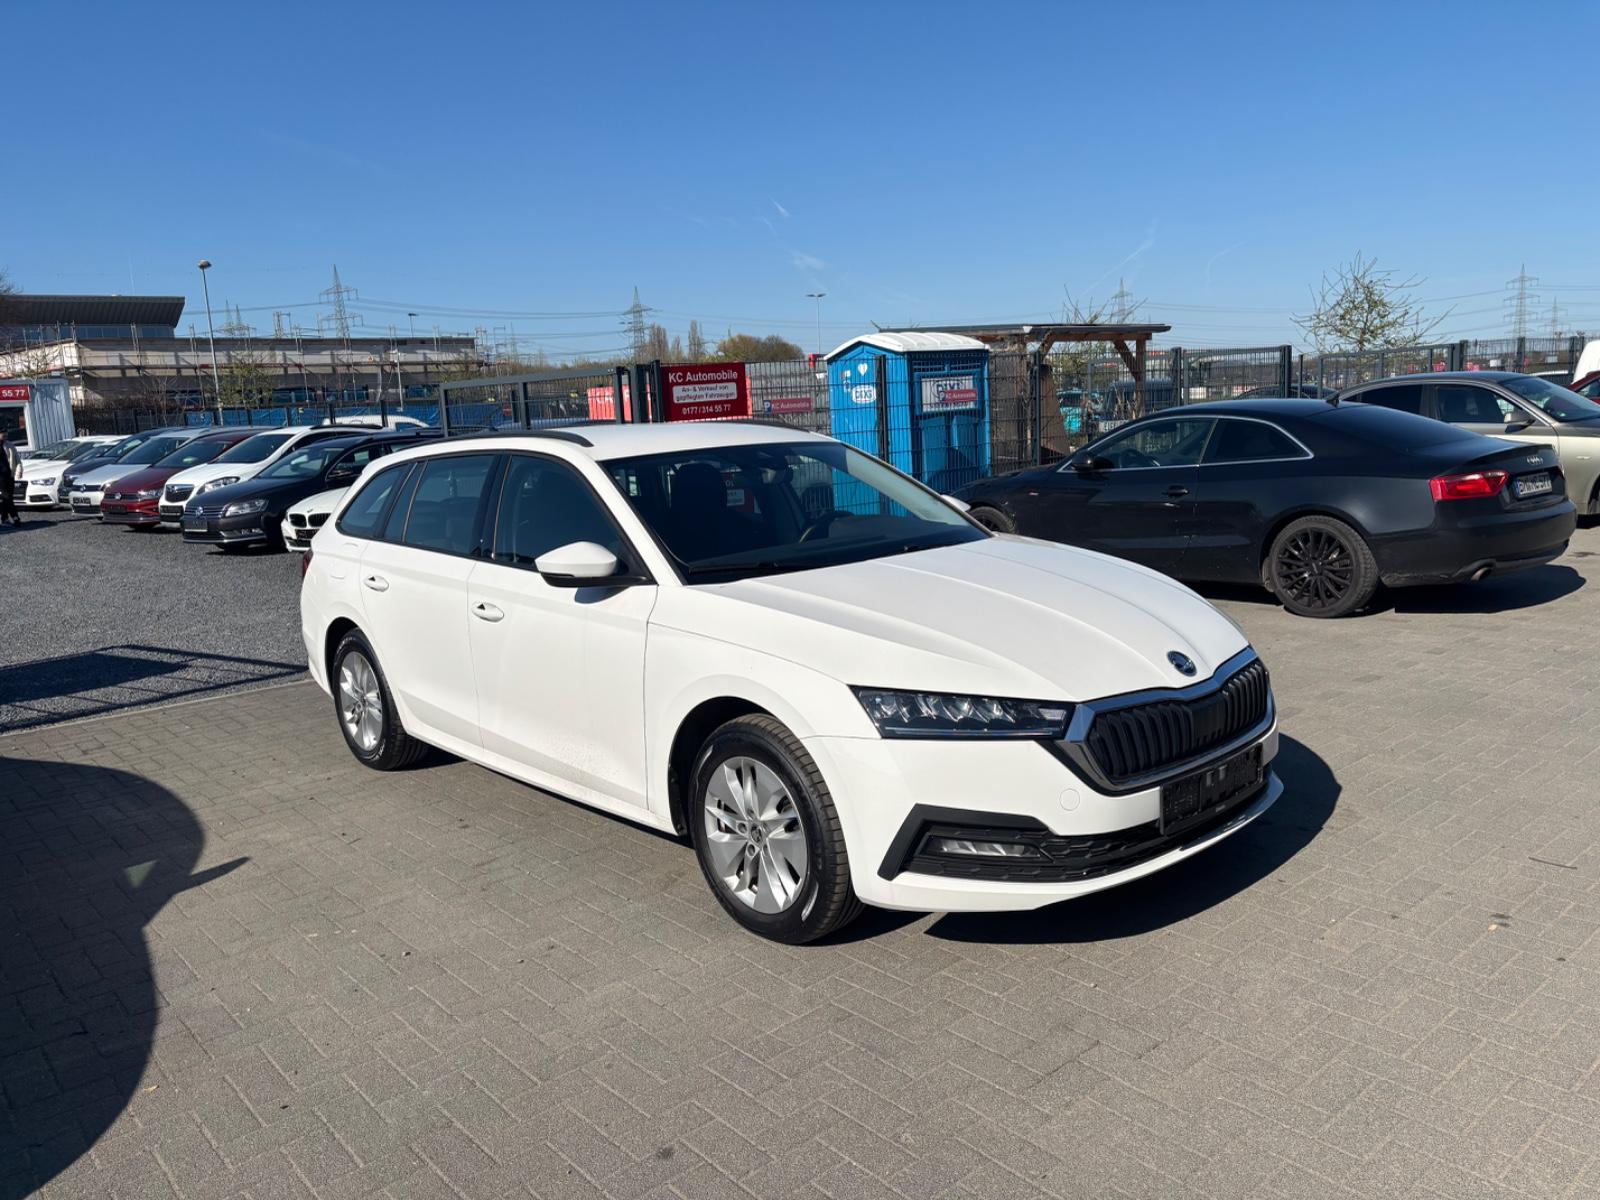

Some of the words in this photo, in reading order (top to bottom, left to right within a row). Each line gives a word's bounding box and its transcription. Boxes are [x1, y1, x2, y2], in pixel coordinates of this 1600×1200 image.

[668, 372, 684, 383] KC
[685, 370, 738, 382] Automobile
[2, 389, 13, 397] 55
[14, 389, 25, 397] 77
